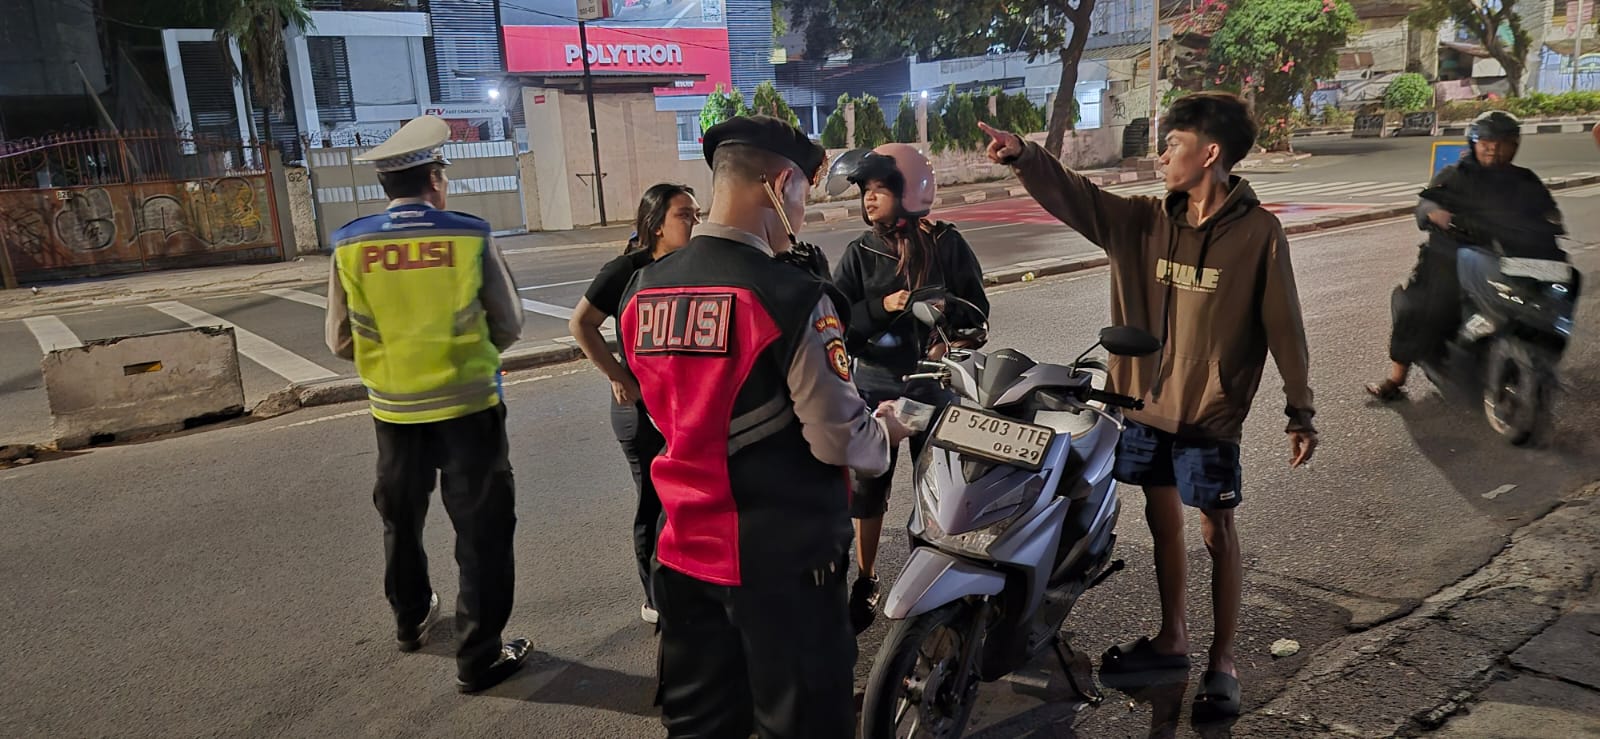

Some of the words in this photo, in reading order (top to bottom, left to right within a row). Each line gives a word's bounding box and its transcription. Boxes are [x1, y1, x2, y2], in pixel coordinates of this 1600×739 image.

[565, 44, 682, 64] POLYTRON
[362, 241, 456, 273] POLISI
[637, 300, 728, 347] POLISI
[948, 409, 960, 423] B
[968, 414, 1010, 436] 5403
[1017, 426, 1049, 447] TTE
